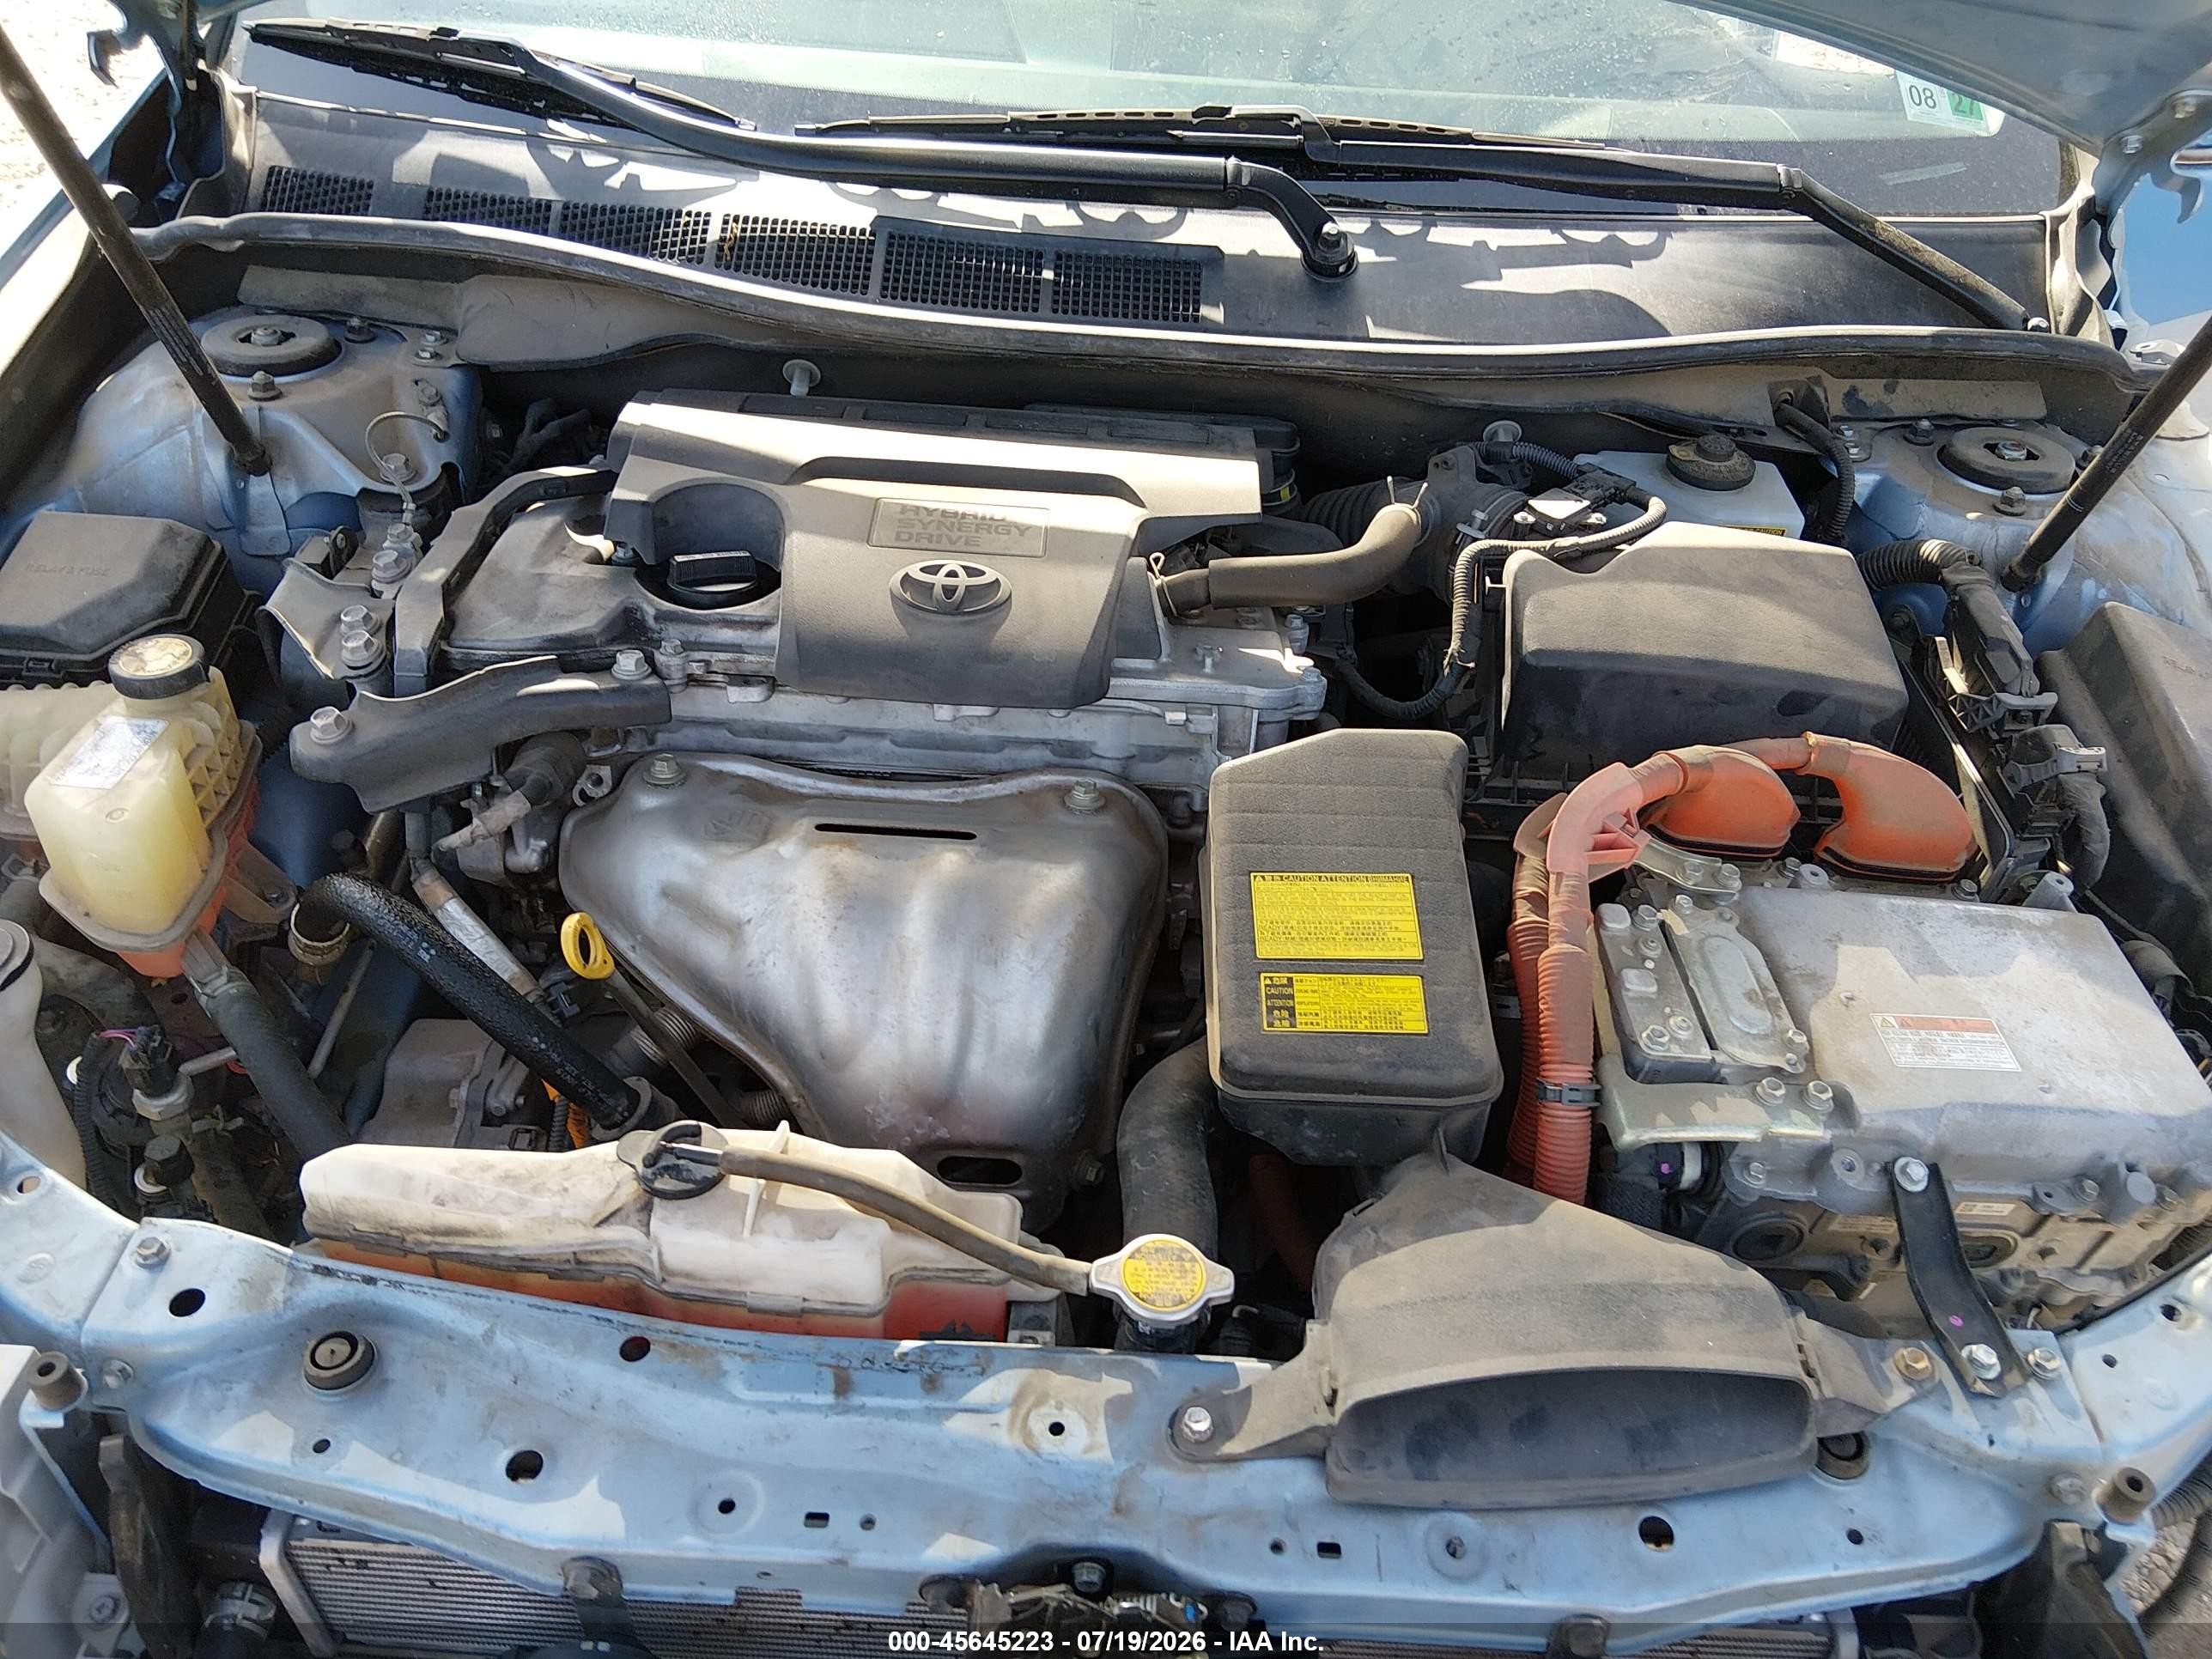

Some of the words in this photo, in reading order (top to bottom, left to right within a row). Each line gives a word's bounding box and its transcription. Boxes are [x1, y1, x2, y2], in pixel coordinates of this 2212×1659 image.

[1909, 85, 1937, 109] 08
[896, 518, 1032, 537] SYNERGY
[894, 531, 981, 547] DRIVE
